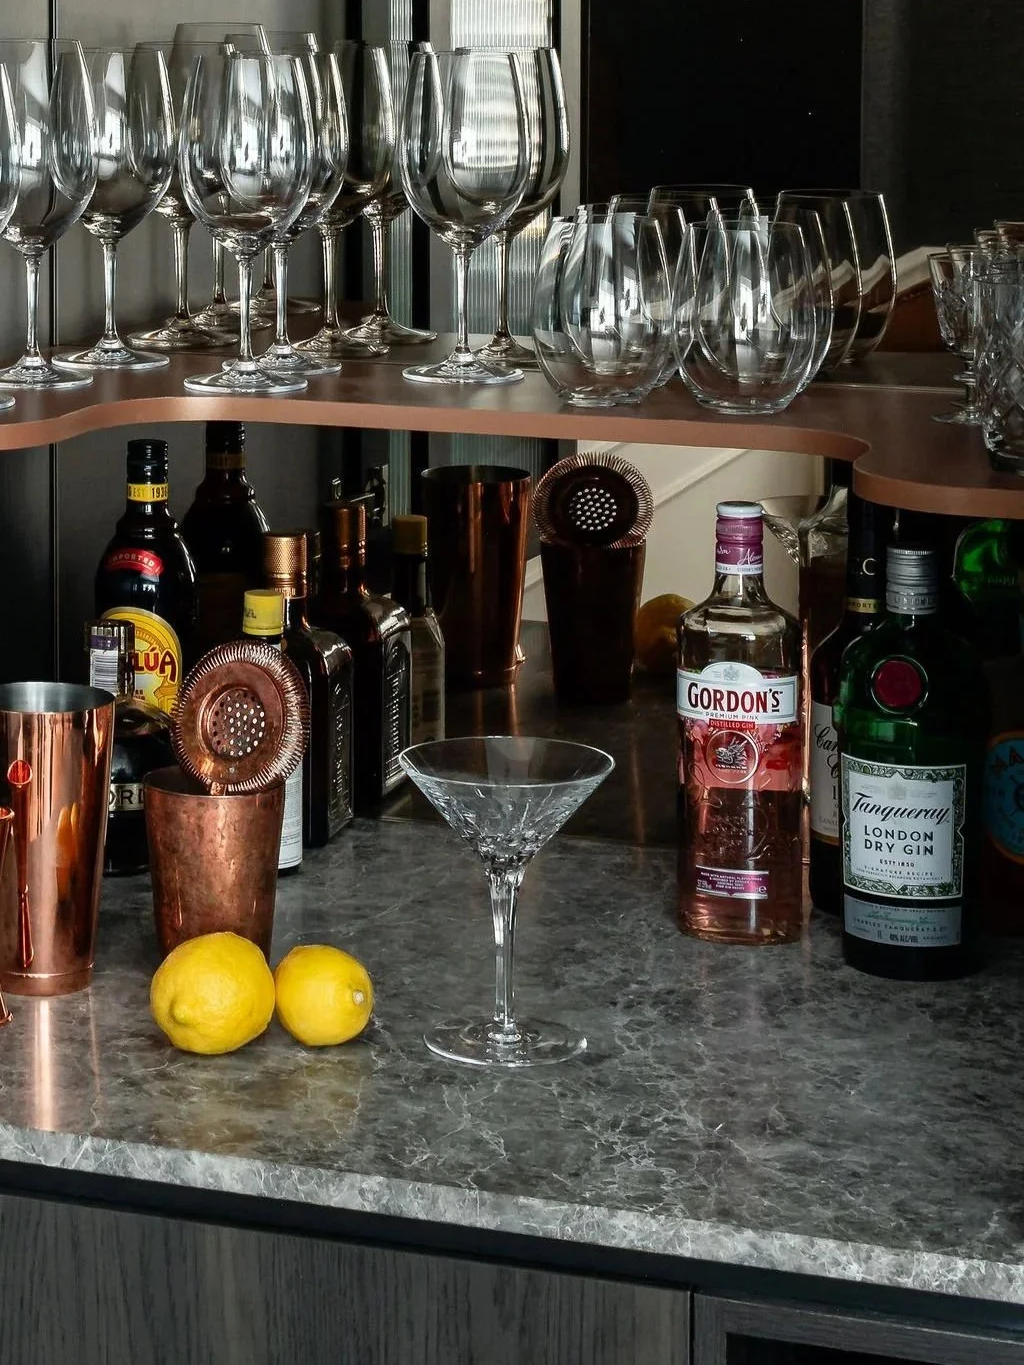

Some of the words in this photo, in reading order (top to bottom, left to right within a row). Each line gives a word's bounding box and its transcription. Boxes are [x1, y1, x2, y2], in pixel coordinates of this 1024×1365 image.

[133, 487, 145, 497] EST
[111, 553, 155, 567] MPORTED
[134, 644, 177, 683] LÚA
[687, 682, 780, 713] GORDON'S
[705, 711, 739, 720] PREMIUM
[710, 720, 741, 728] DISTILLED
[852, 792, 949, 825] Tanqueray
[864, 825, 934, 842] LONDON
[864, 838, 895, 853] DRY
[903, 844, 934, 856] GIN
